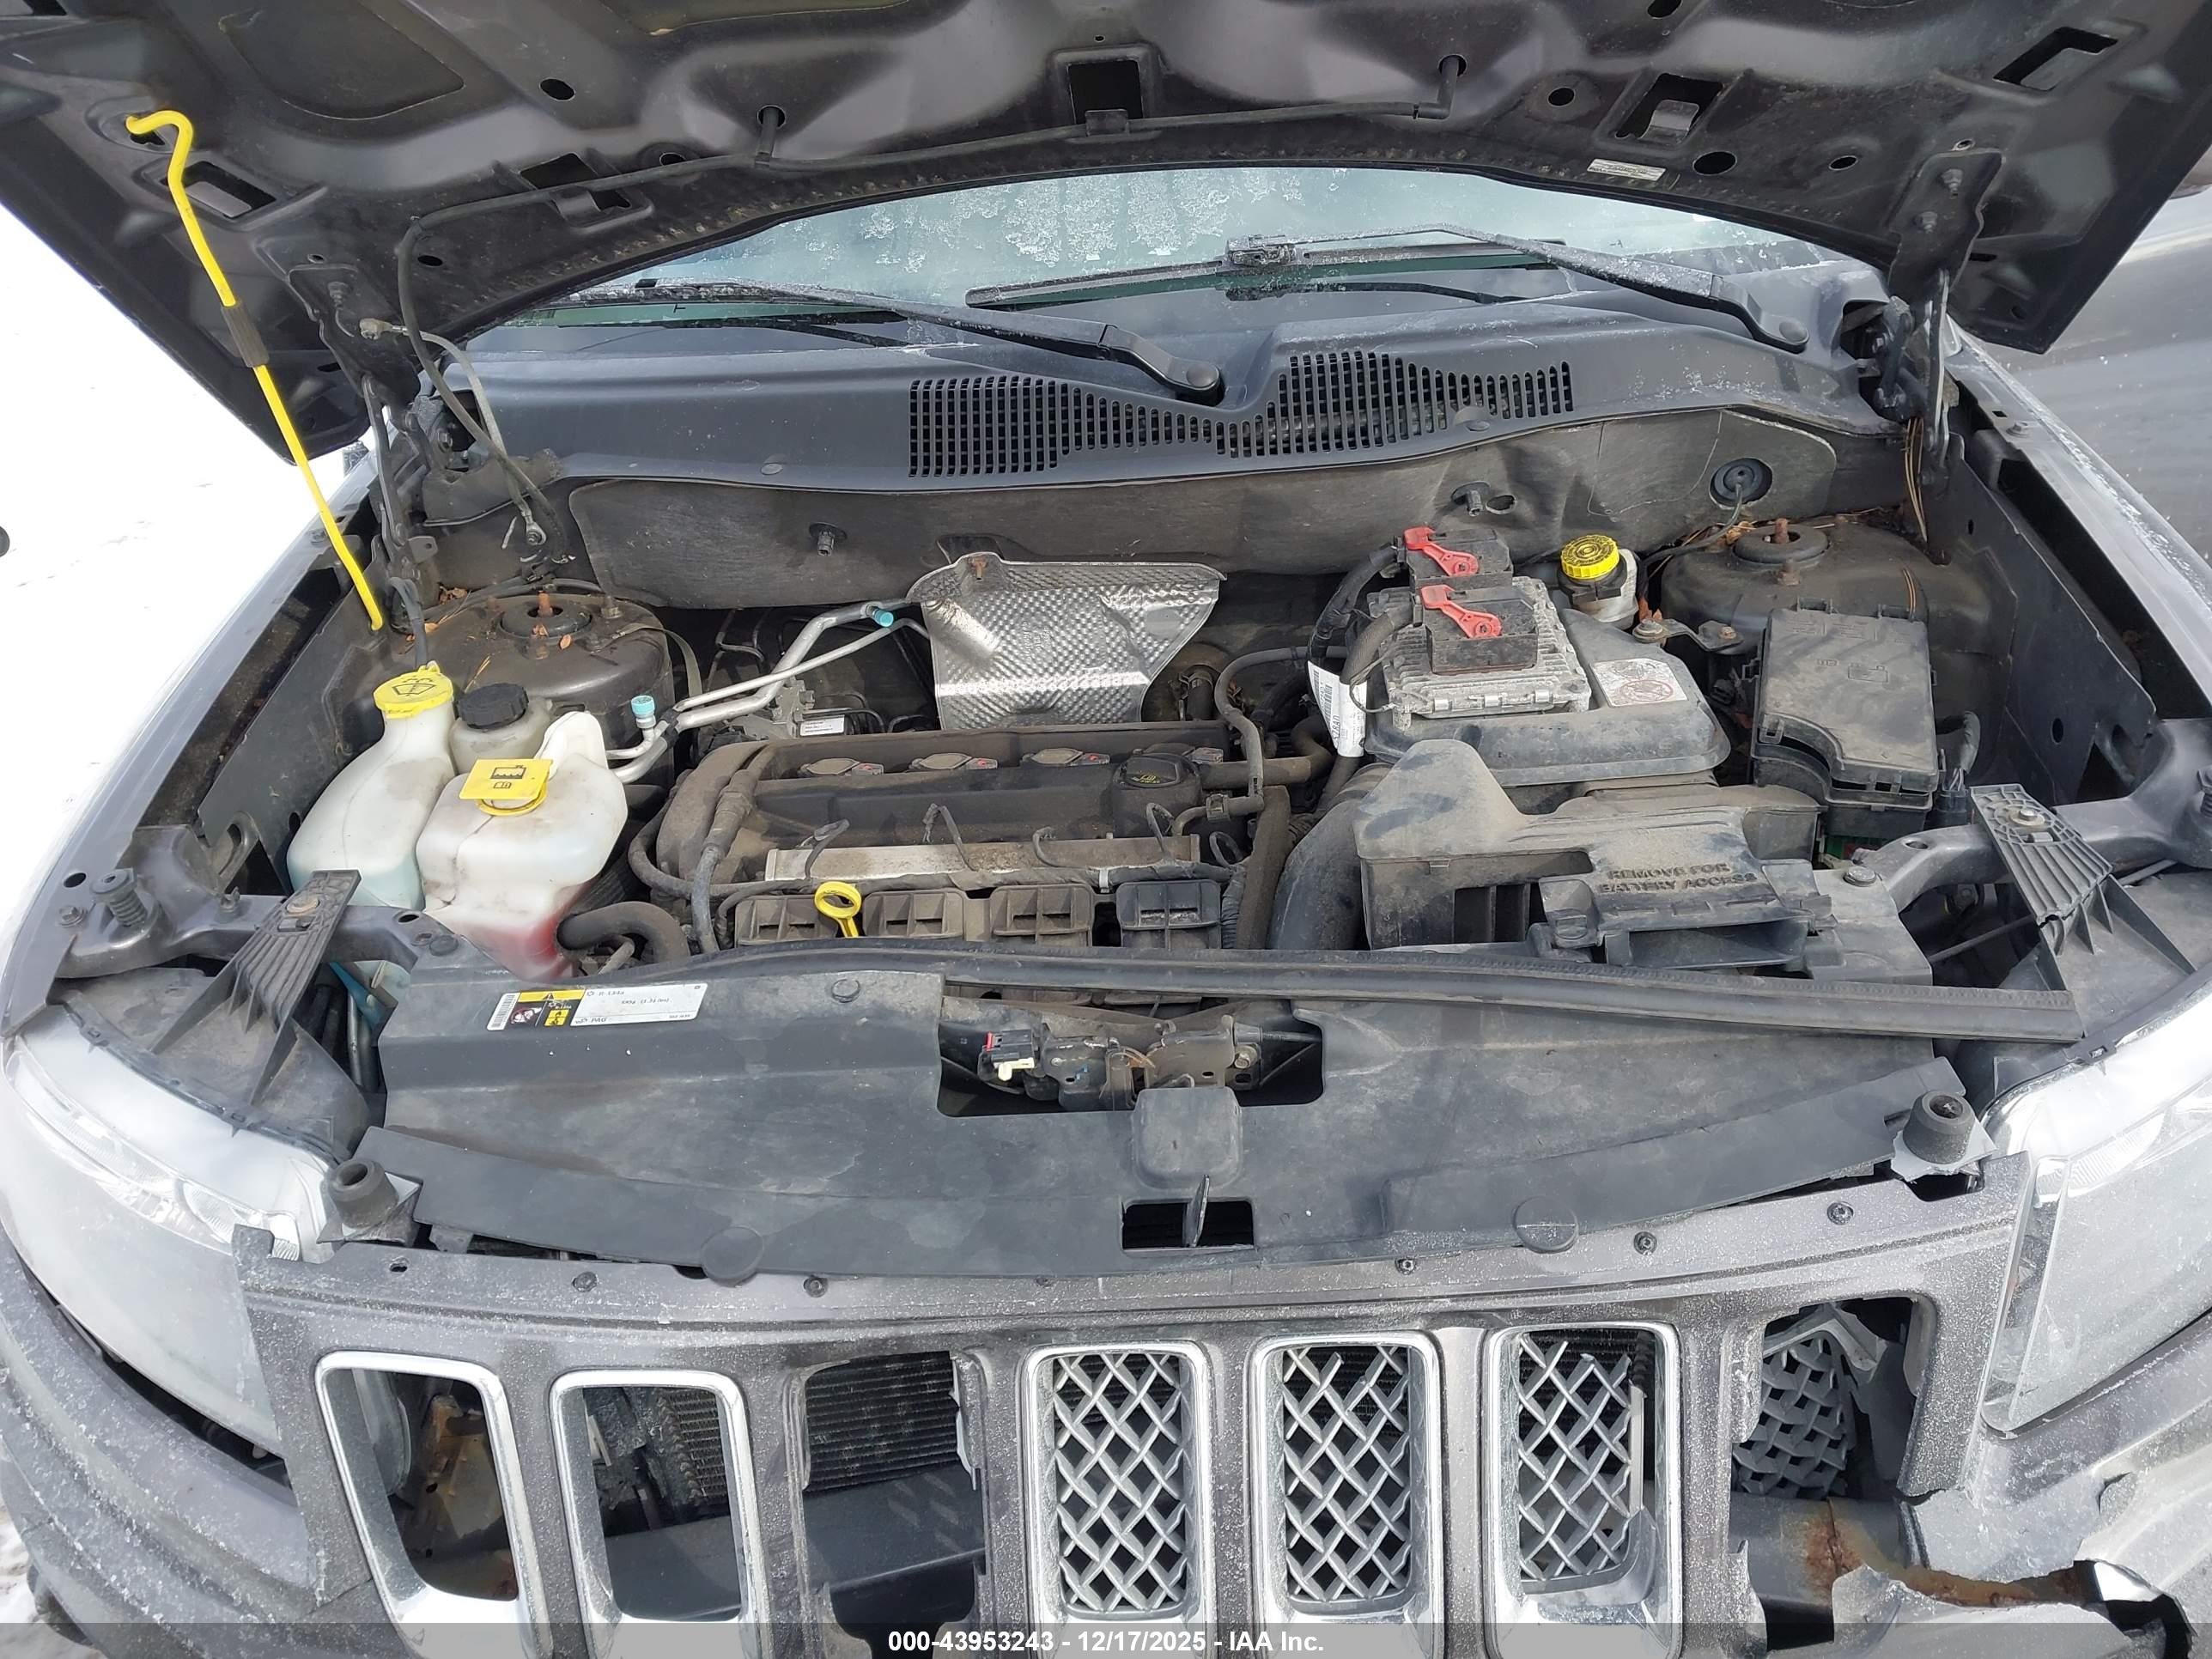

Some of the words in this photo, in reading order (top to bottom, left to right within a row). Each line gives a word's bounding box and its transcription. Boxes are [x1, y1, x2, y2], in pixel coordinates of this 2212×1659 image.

[1607, 866, 1686, 880] REMOVE
[1690, 863, 1732, 874] FOR
[1599, 880, 1676, 893] BATTERY
[1684, 872, 1758, 890] ACCESS
